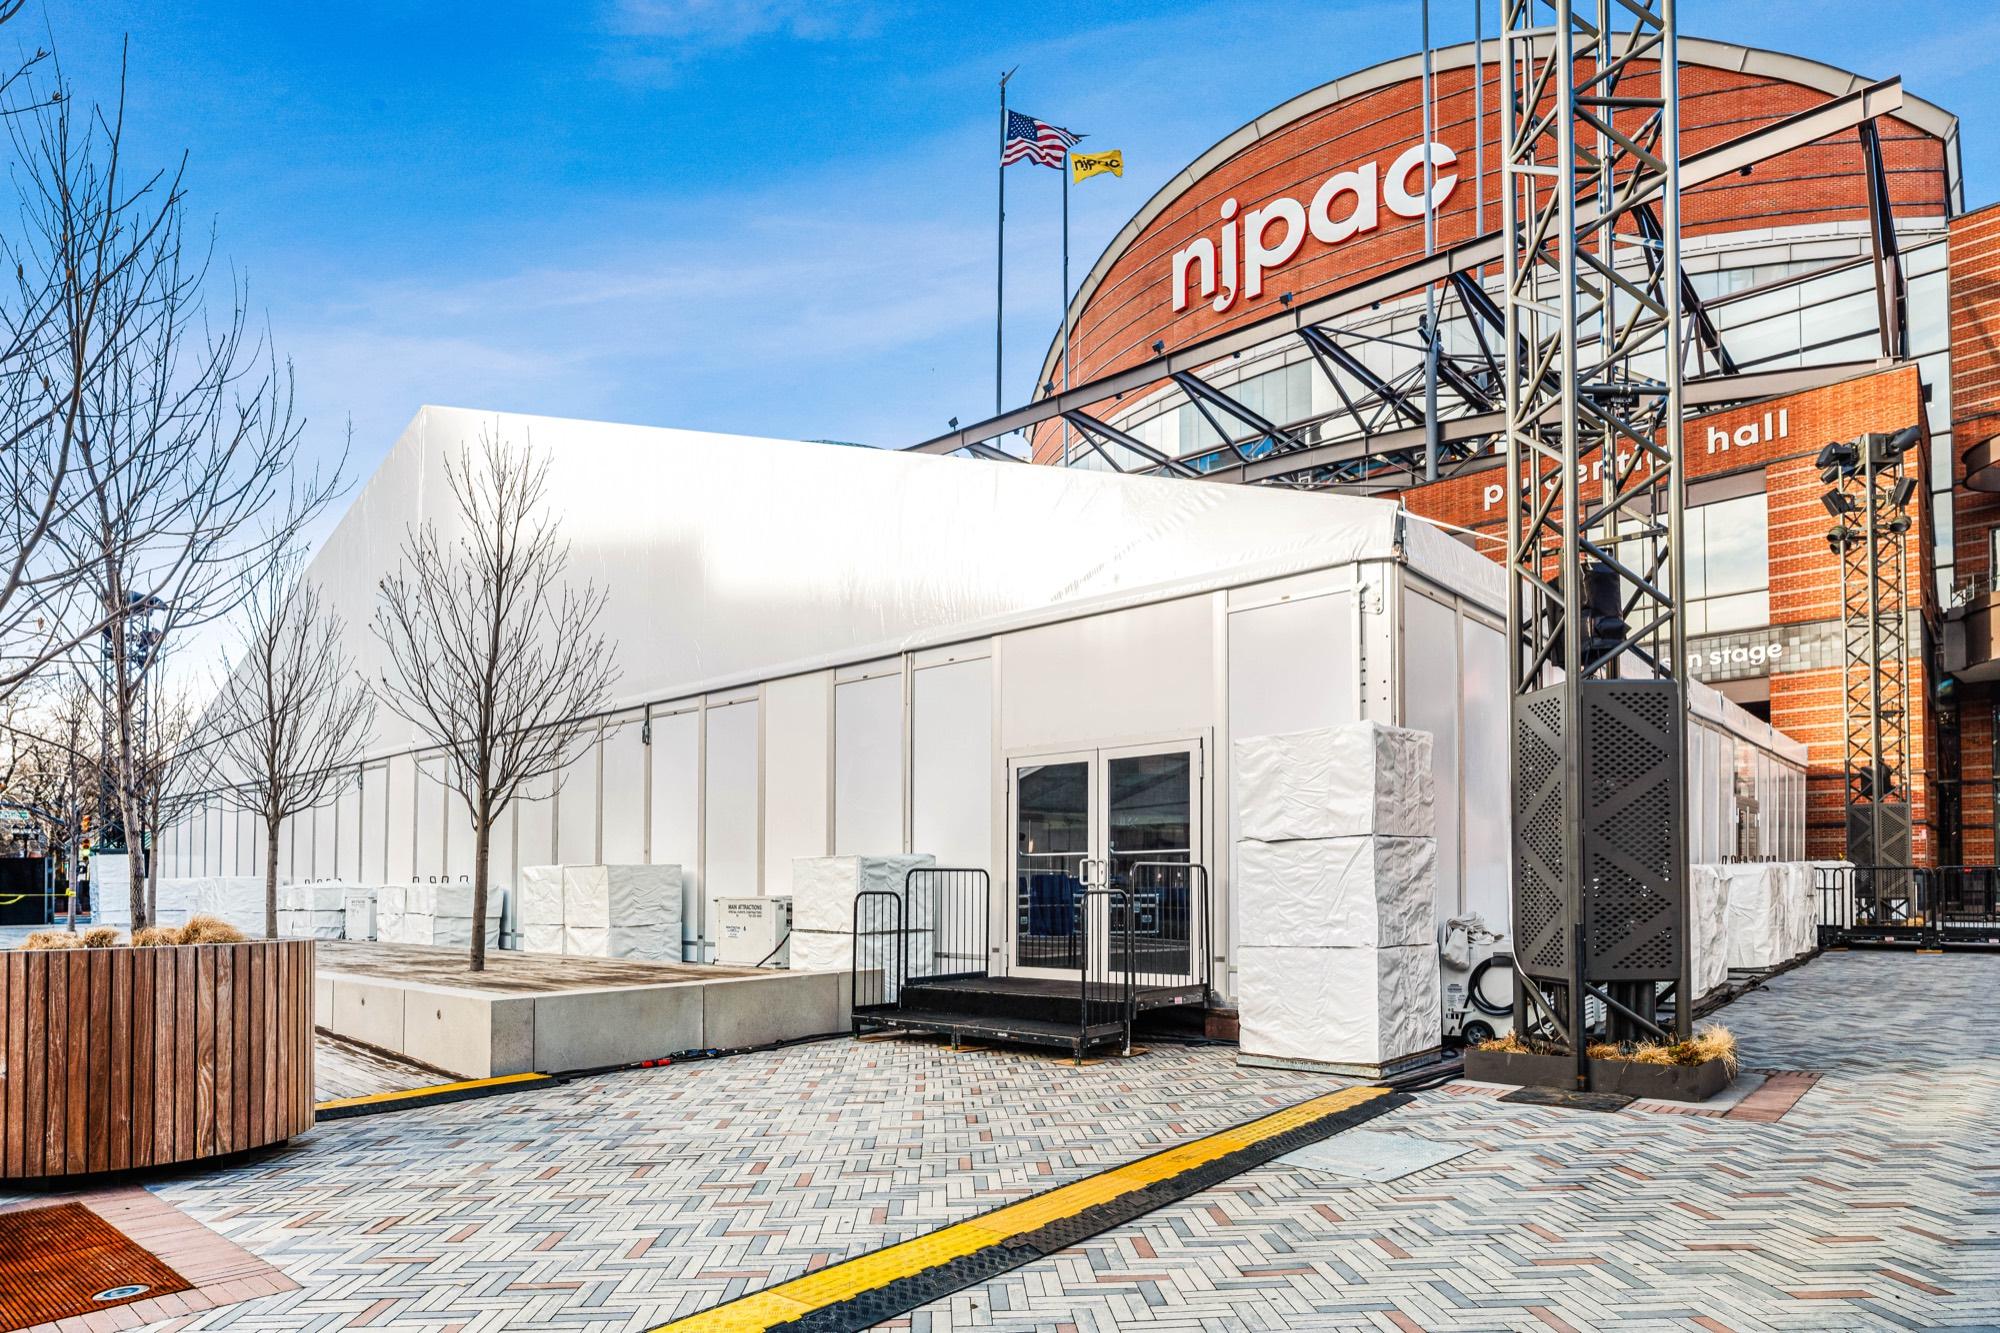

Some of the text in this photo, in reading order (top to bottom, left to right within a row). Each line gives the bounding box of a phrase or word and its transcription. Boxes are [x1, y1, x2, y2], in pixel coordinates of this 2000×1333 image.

[1172, 142, 1458, 314] njpac
[1707, 408, 1790, 455] hall
[1709, 643, 1783, 666] stage
